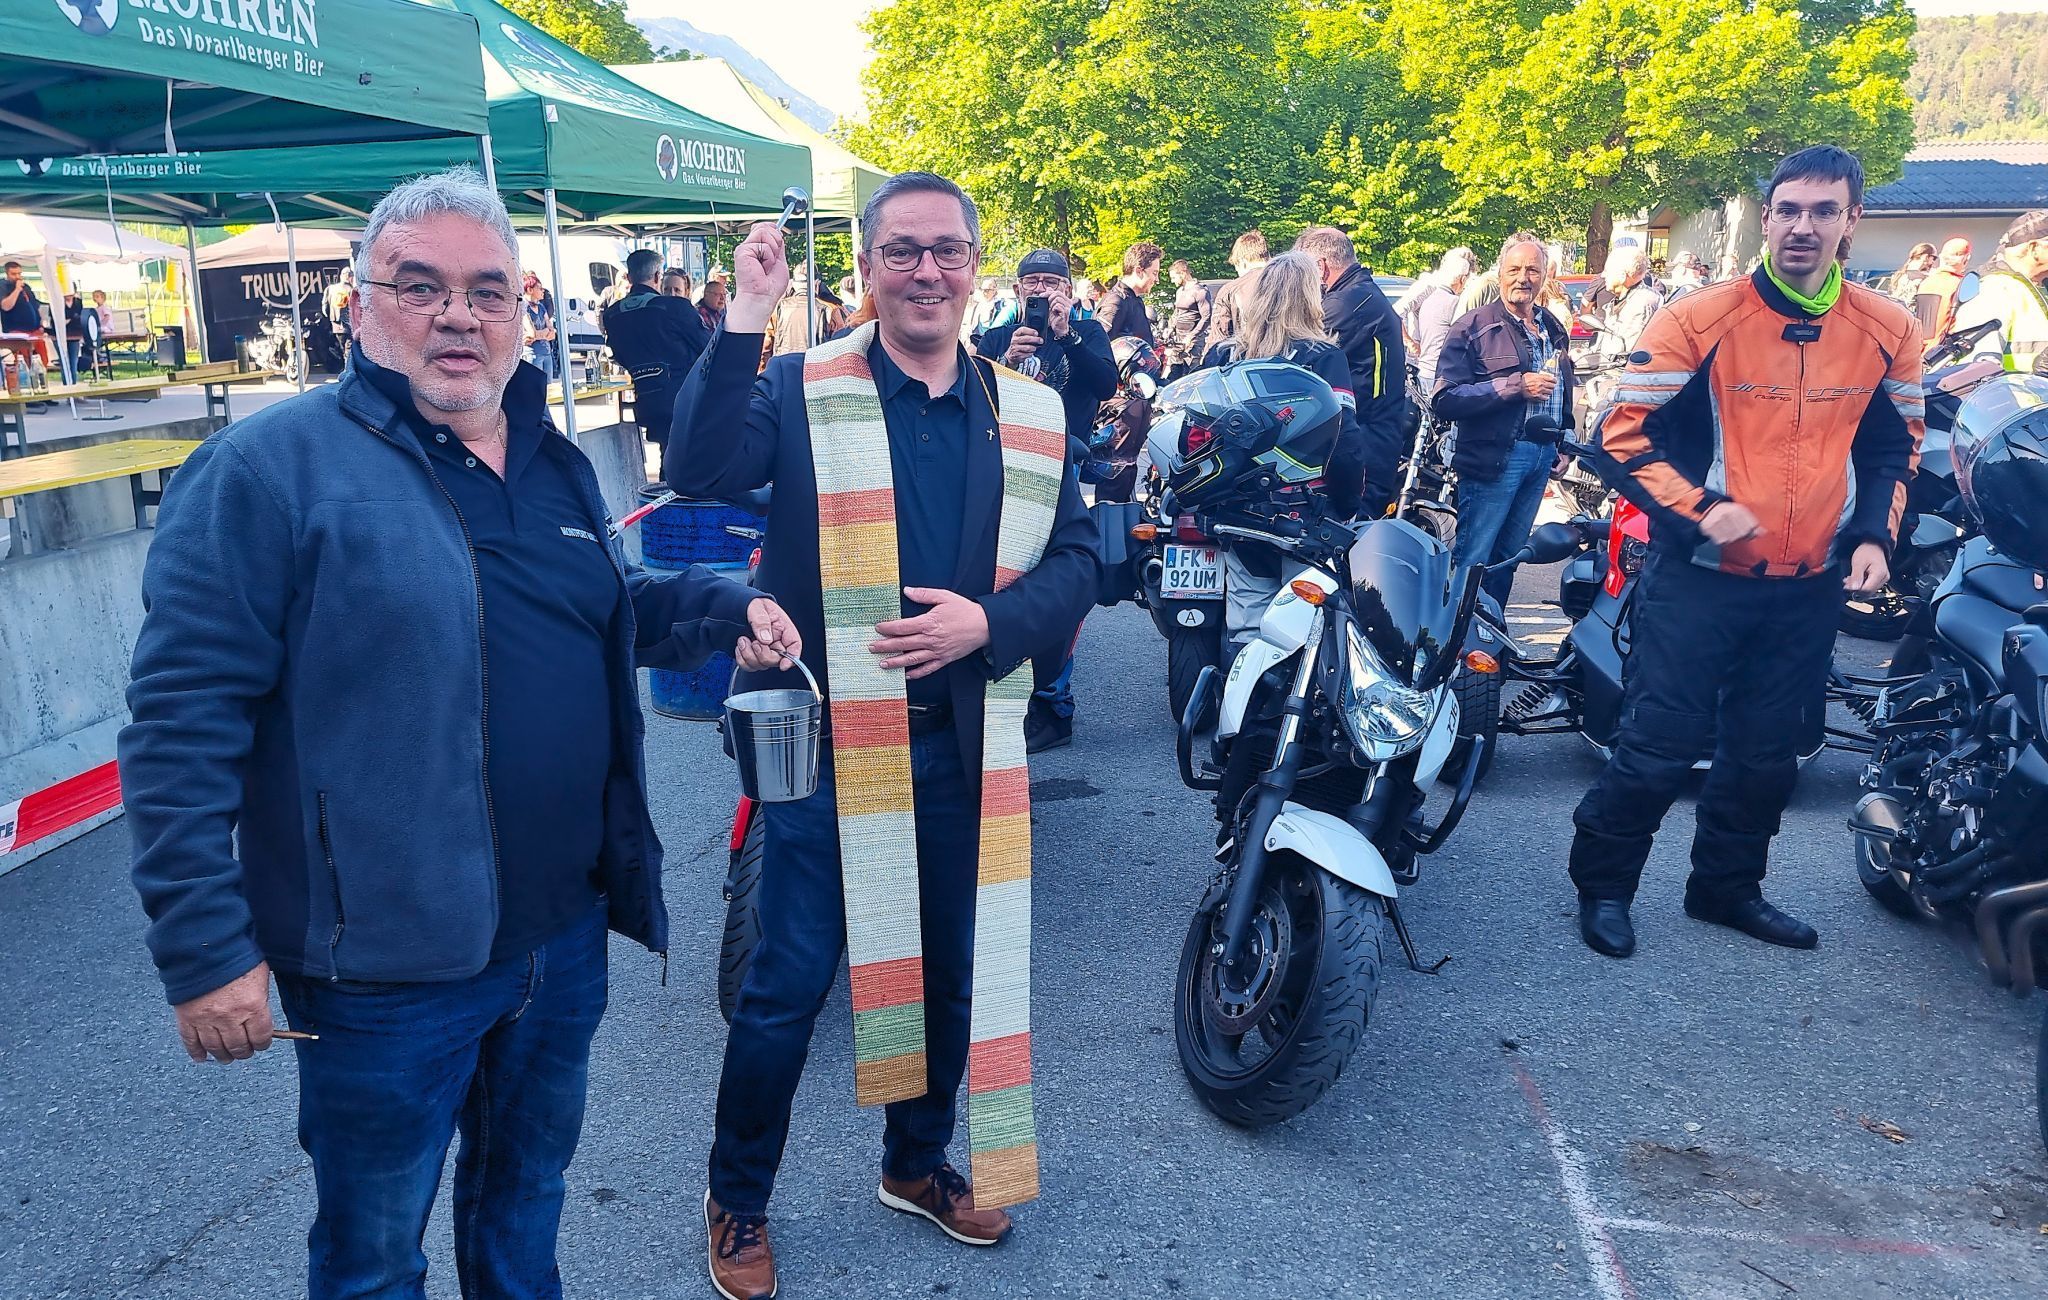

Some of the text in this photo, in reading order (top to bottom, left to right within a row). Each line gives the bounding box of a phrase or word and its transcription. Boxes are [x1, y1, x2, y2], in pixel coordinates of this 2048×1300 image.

[137, 16, 325, 77] Das Vorarlberger Bier
[678, 139, 746, 175] MOHREN
[62, 161, 202, 178] Das Vorarlberger Bier
[682, 171, 695, 185] Das
[734, 178, 746, 190] Bier
[241, 270, 323, 301] TRIUMPH
[1180, 549, 1201, 568] FK
[1170, 569, 1217, 589] 92 UM
[1184, 611, 1197, 624] A
